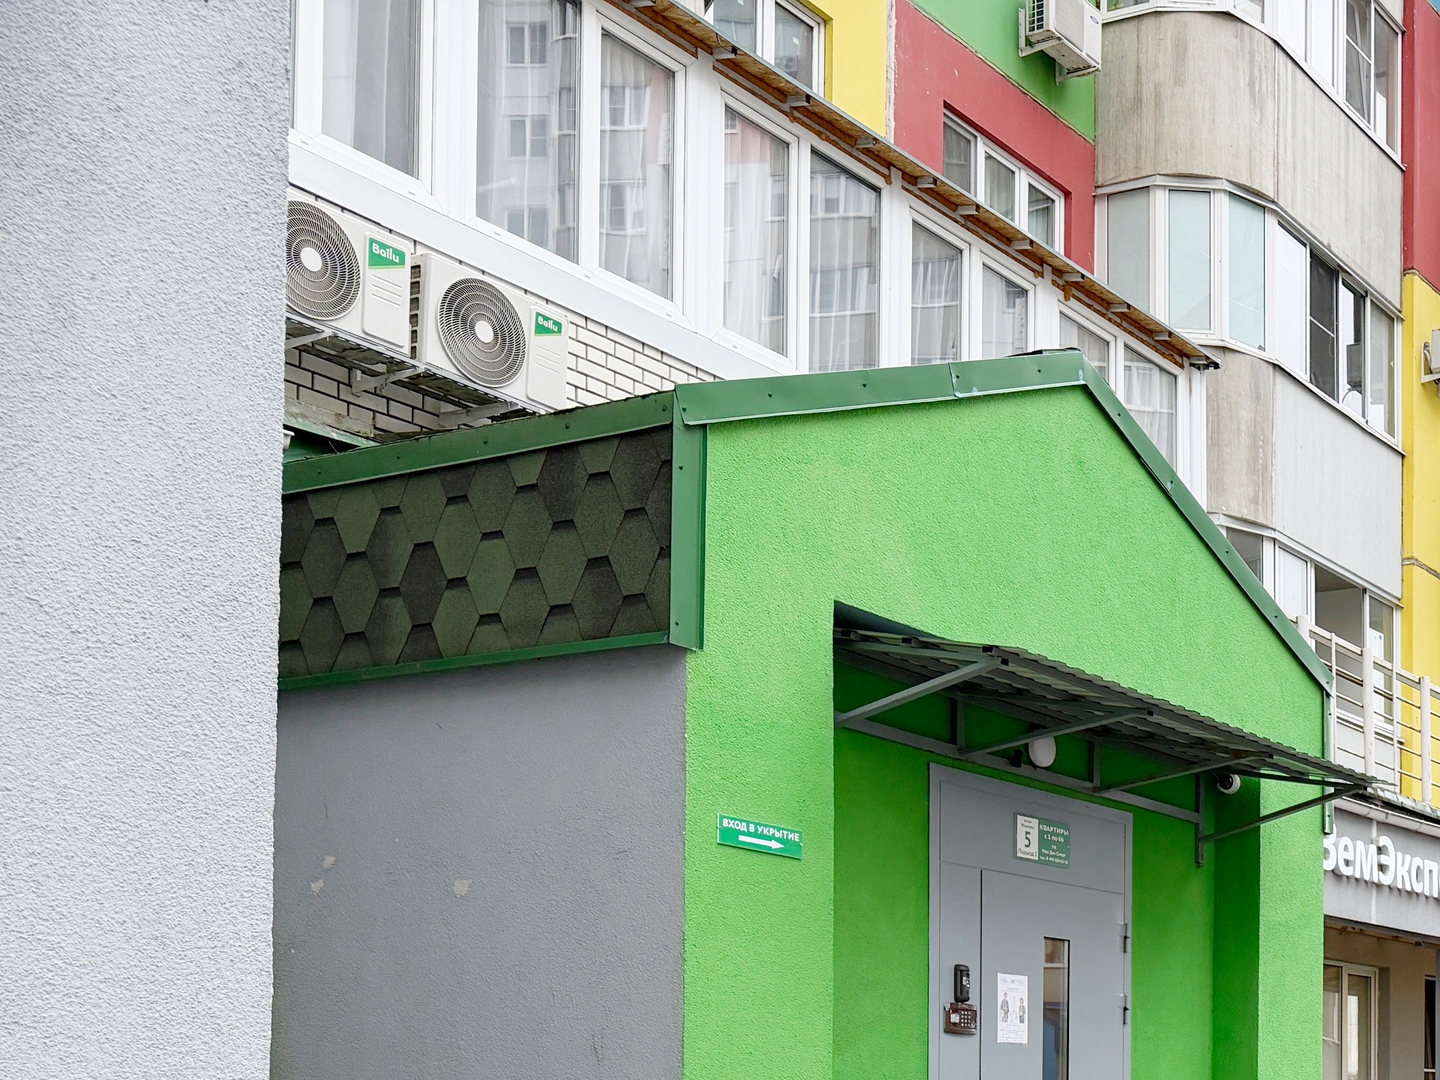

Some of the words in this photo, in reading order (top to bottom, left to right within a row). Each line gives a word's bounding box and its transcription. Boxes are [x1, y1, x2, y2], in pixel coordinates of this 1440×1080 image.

[372, 242, 400, 264] Ballu
[537, 315, 558, 333] Ballu
[722, 818, 747, 832] ВХОД
[749, 824, 755, 833] В
[757, 825, 800, 842] УКРЫТИЕ
[1040, 824, 1069, 836] КВАРТИРЫ
[1024, 831, 1031, 848] 5
